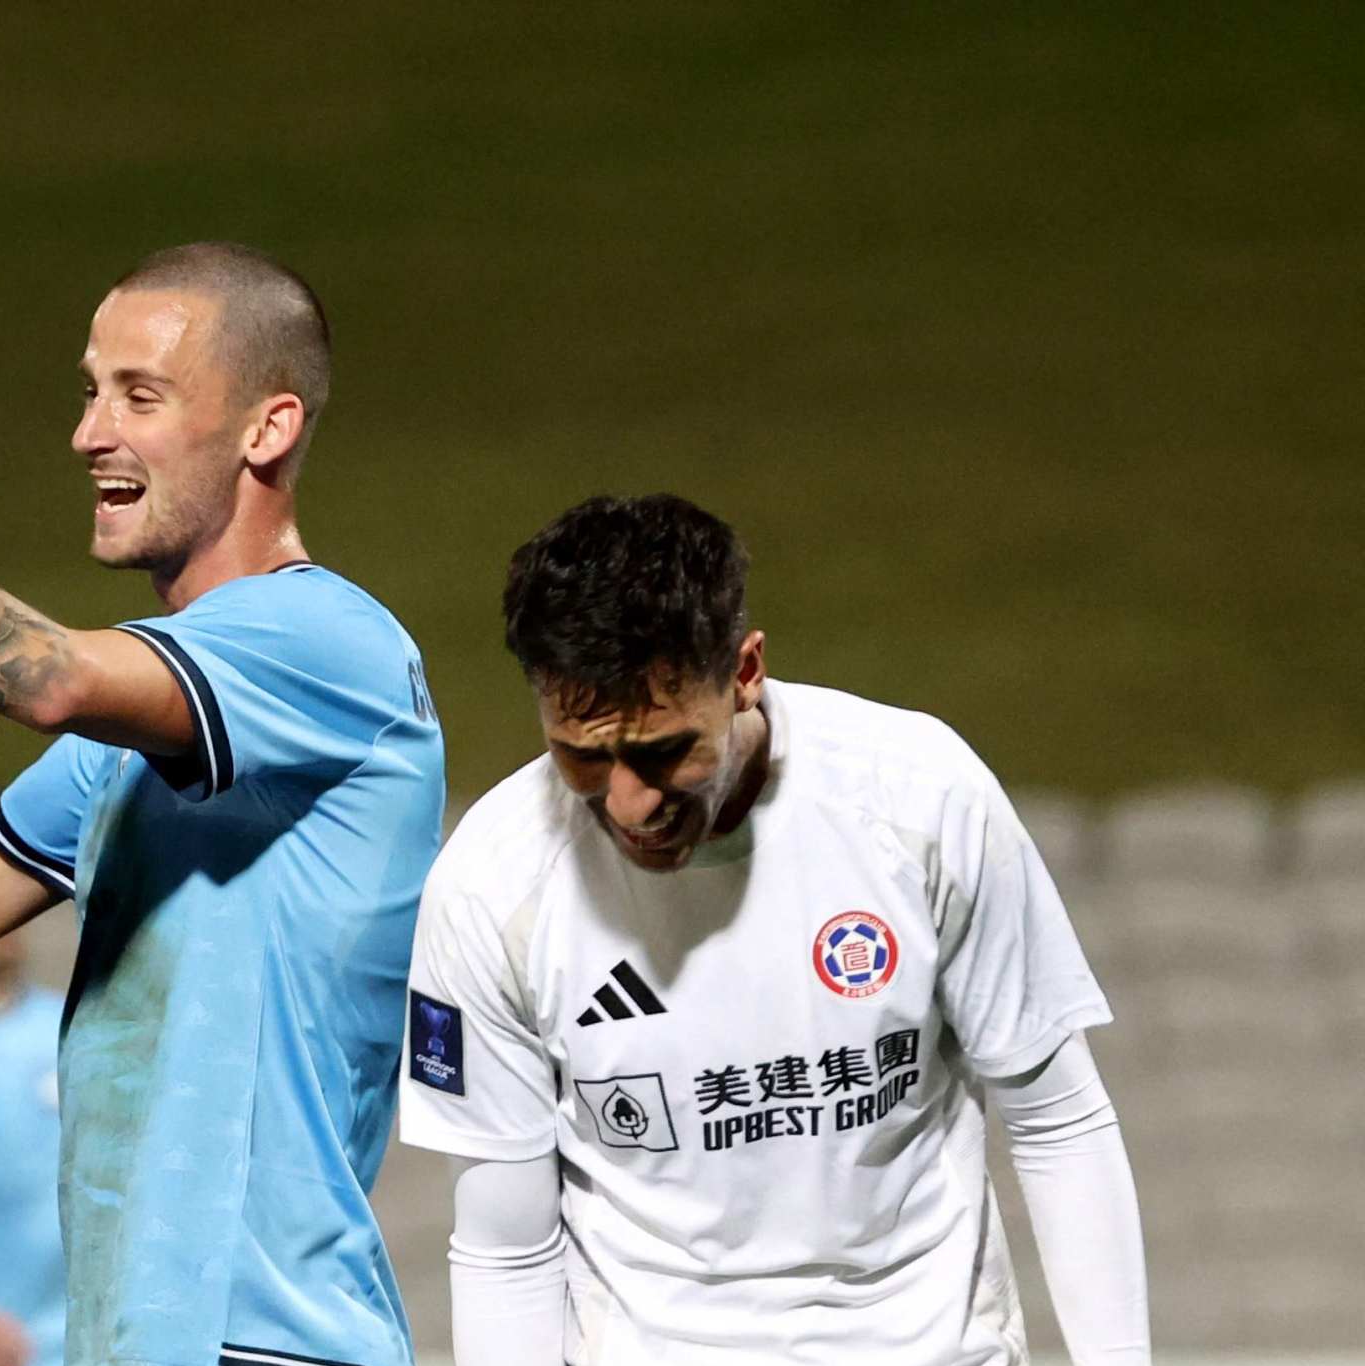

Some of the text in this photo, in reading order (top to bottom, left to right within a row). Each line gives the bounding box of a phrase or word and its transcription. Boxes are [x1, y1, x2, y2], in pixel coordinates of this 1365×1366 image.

[694, 1028, 920, 1115] 美建集團
[703, 1069, 920, 1151] UPBEST GROUP
